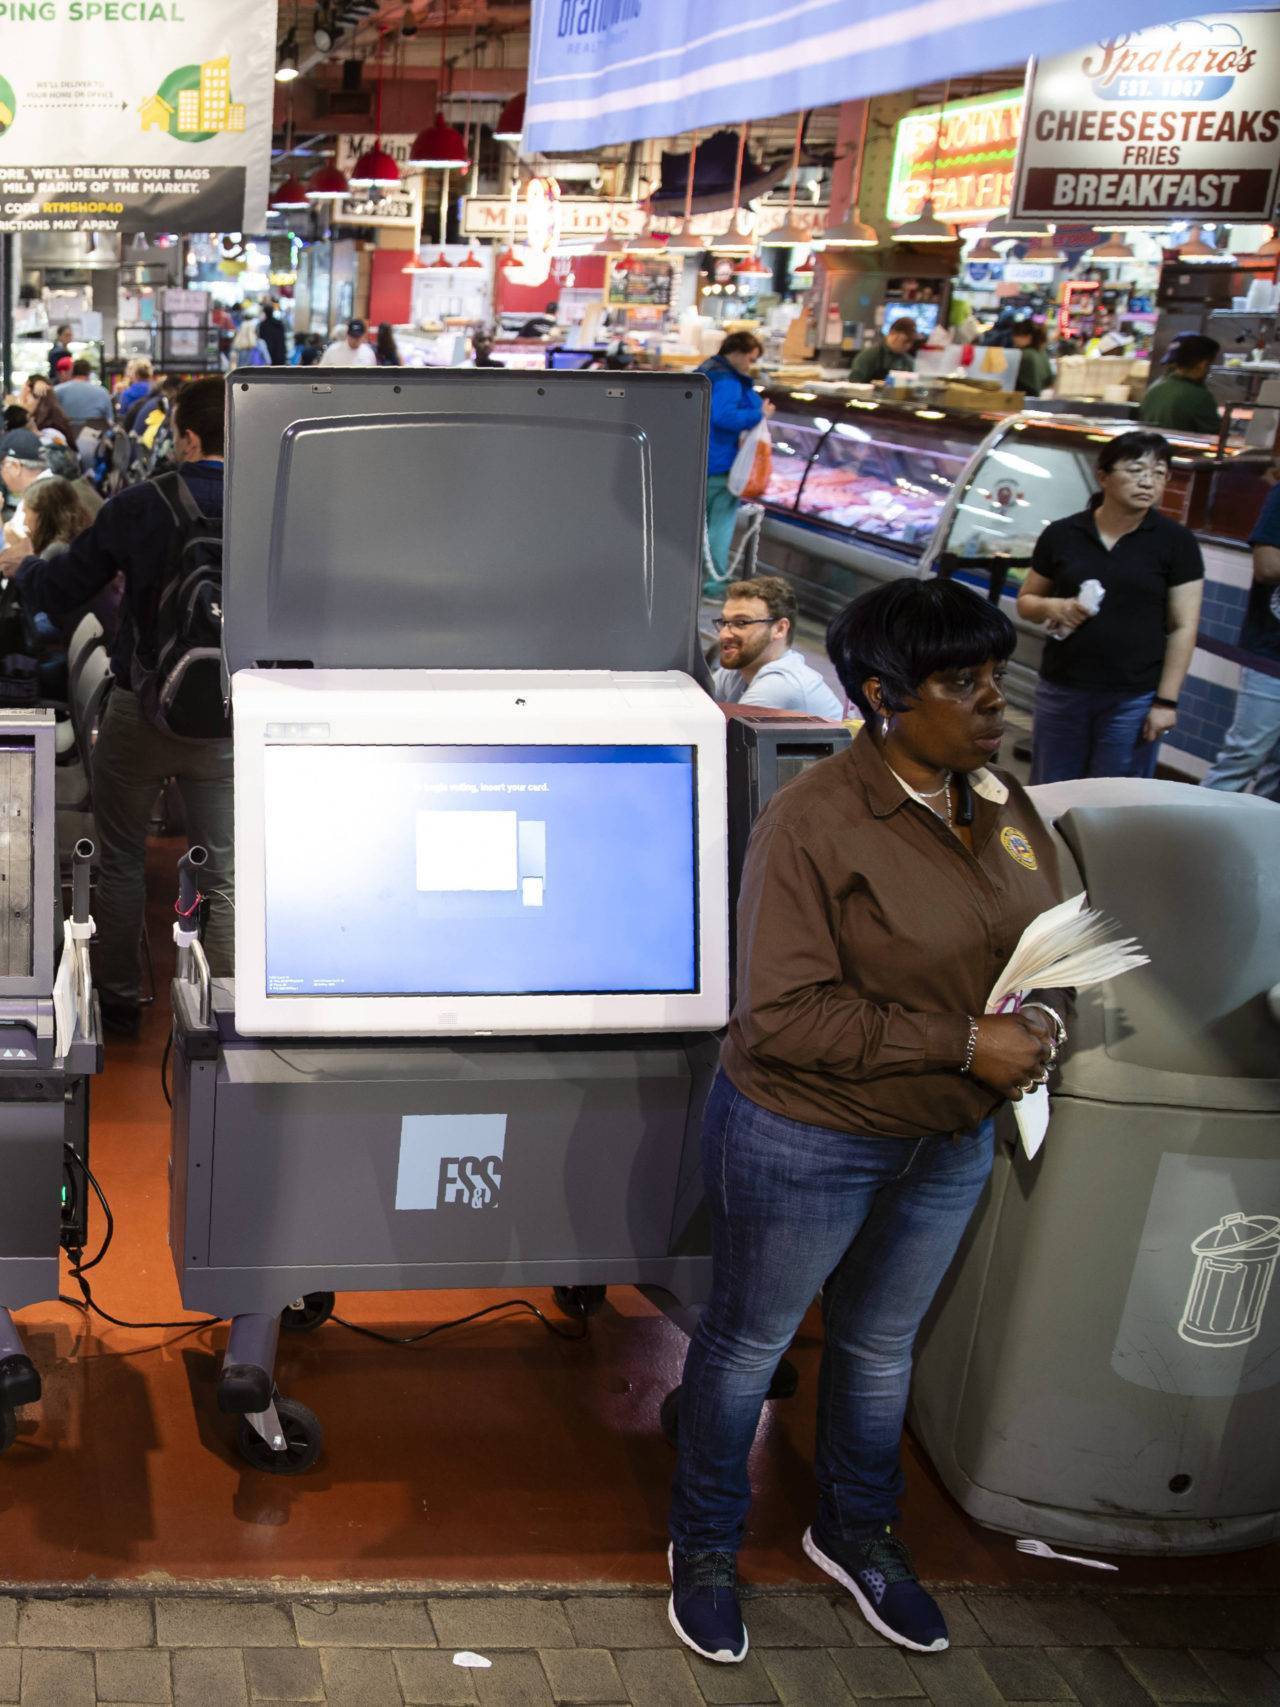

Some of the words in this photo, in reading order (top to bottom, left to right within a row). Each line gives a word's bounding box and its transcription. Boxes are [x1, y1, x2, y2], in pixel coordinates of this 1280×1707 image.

[69, 2, 185, 22] SPECIAL
[1118, 79, 1153, 97] EST.
[1035, 109, 1280, 142] CHEESESTEAKS
[1122, 146, 1180, 165] FRIES
[73, 168, 129, 180] DELIVER
[134, 168, 171, 180] YOUR
[174, 169, 210, 180] BAGS
[3, 182, 35, 194] MILE
[39, 182, 87, 193] RADIUS
[90, 182, 110, 193] OF
[113, 182, 139, 193] THE
[143, 182, 200, 194] MARKET.
[1052, 173, 1240, 207] BREAKFAST
[4, 202, 40, 214] CODE
[42, 202, 124, 214] RTMSHOP40
[53, 220, 78, 230] MAY
[81, 220, 119, 230] APPLY
[480, 783, 506, 792] insert
[507, 784, 526, 794] your
[527, 783, 550, 792] card.
